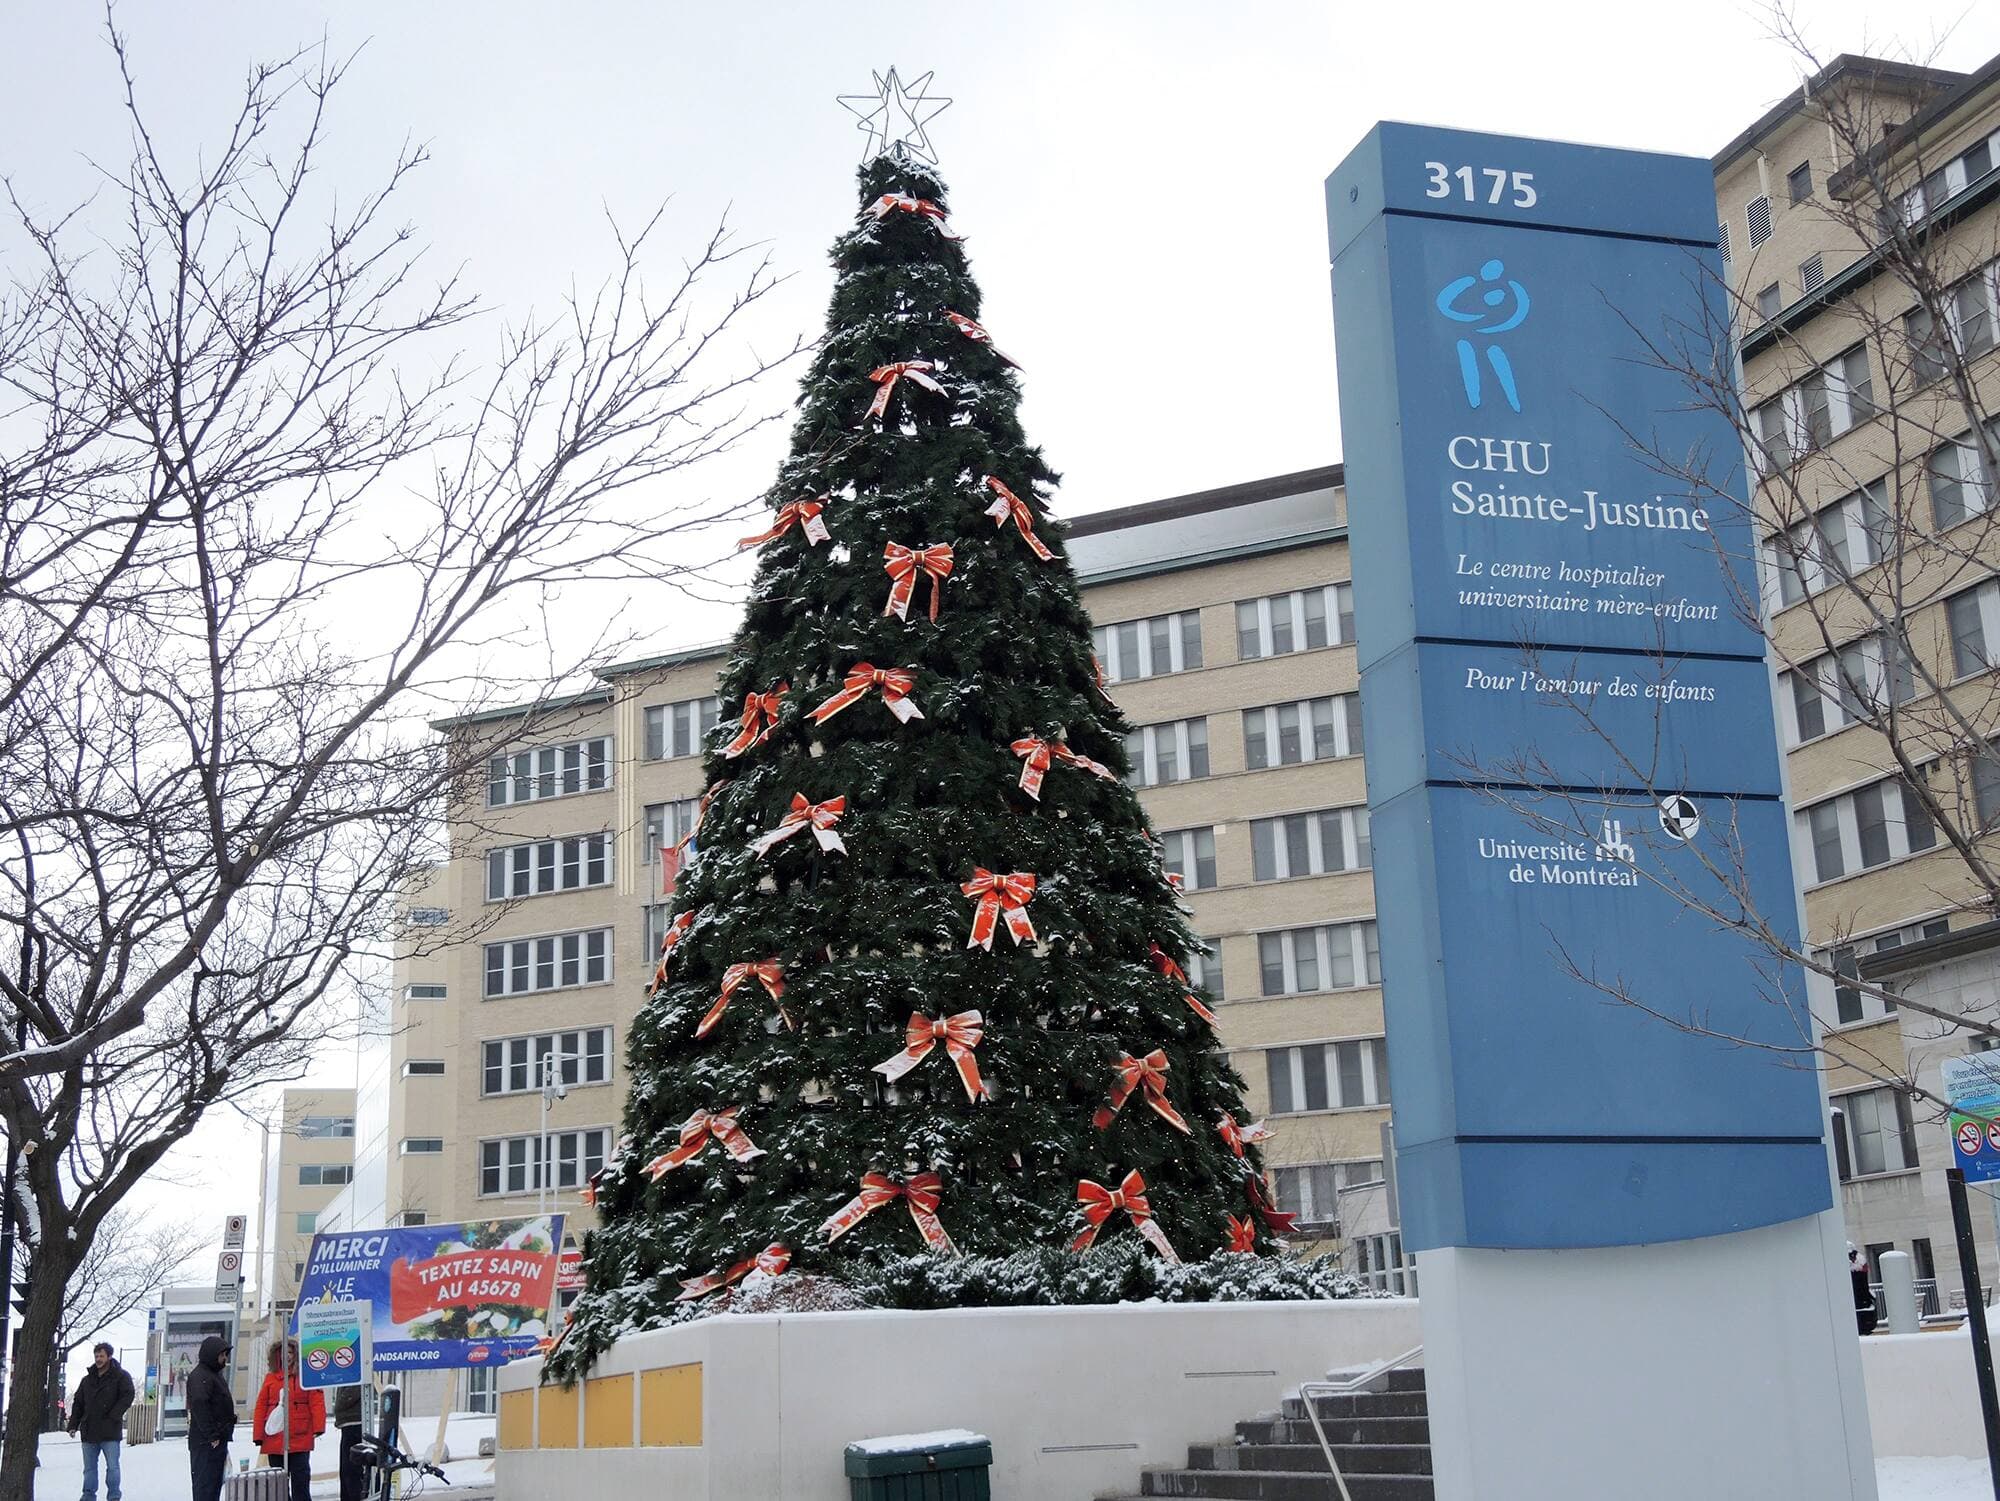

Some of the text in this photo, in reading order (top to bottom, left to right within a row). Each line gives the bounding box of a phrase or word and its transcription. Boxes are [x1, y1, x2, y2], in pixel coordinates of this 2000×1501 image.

[1424, 161, 1538, 209] 3175
[1448, 436, 1552, 476] CHU
[1451, 480, 1710, 532] Sainte-Justine
[1456, 554, 1665, 588] Le centre hospitalier
[1458, 586, 1719, 622] universitaire mère-enfant
[1464, 668, 1515, 691] Pour
[1607, 676, 1638, 698] des
[1645, 680, 1715, 703] enfants
[1478, 838, 1587, 862] Université
[1509, 863, 1639, 886] de Montréal
[315, 1236, 389, 1262] MERCI
[310, 1259, 380, 1276] D'ILLUMINER
[419, 1257, 542, 1285] TEXTEZ SAPIN
[337, 1277, 355, 1293] LE
[437, 1279, 522, 1302] AU 45678
